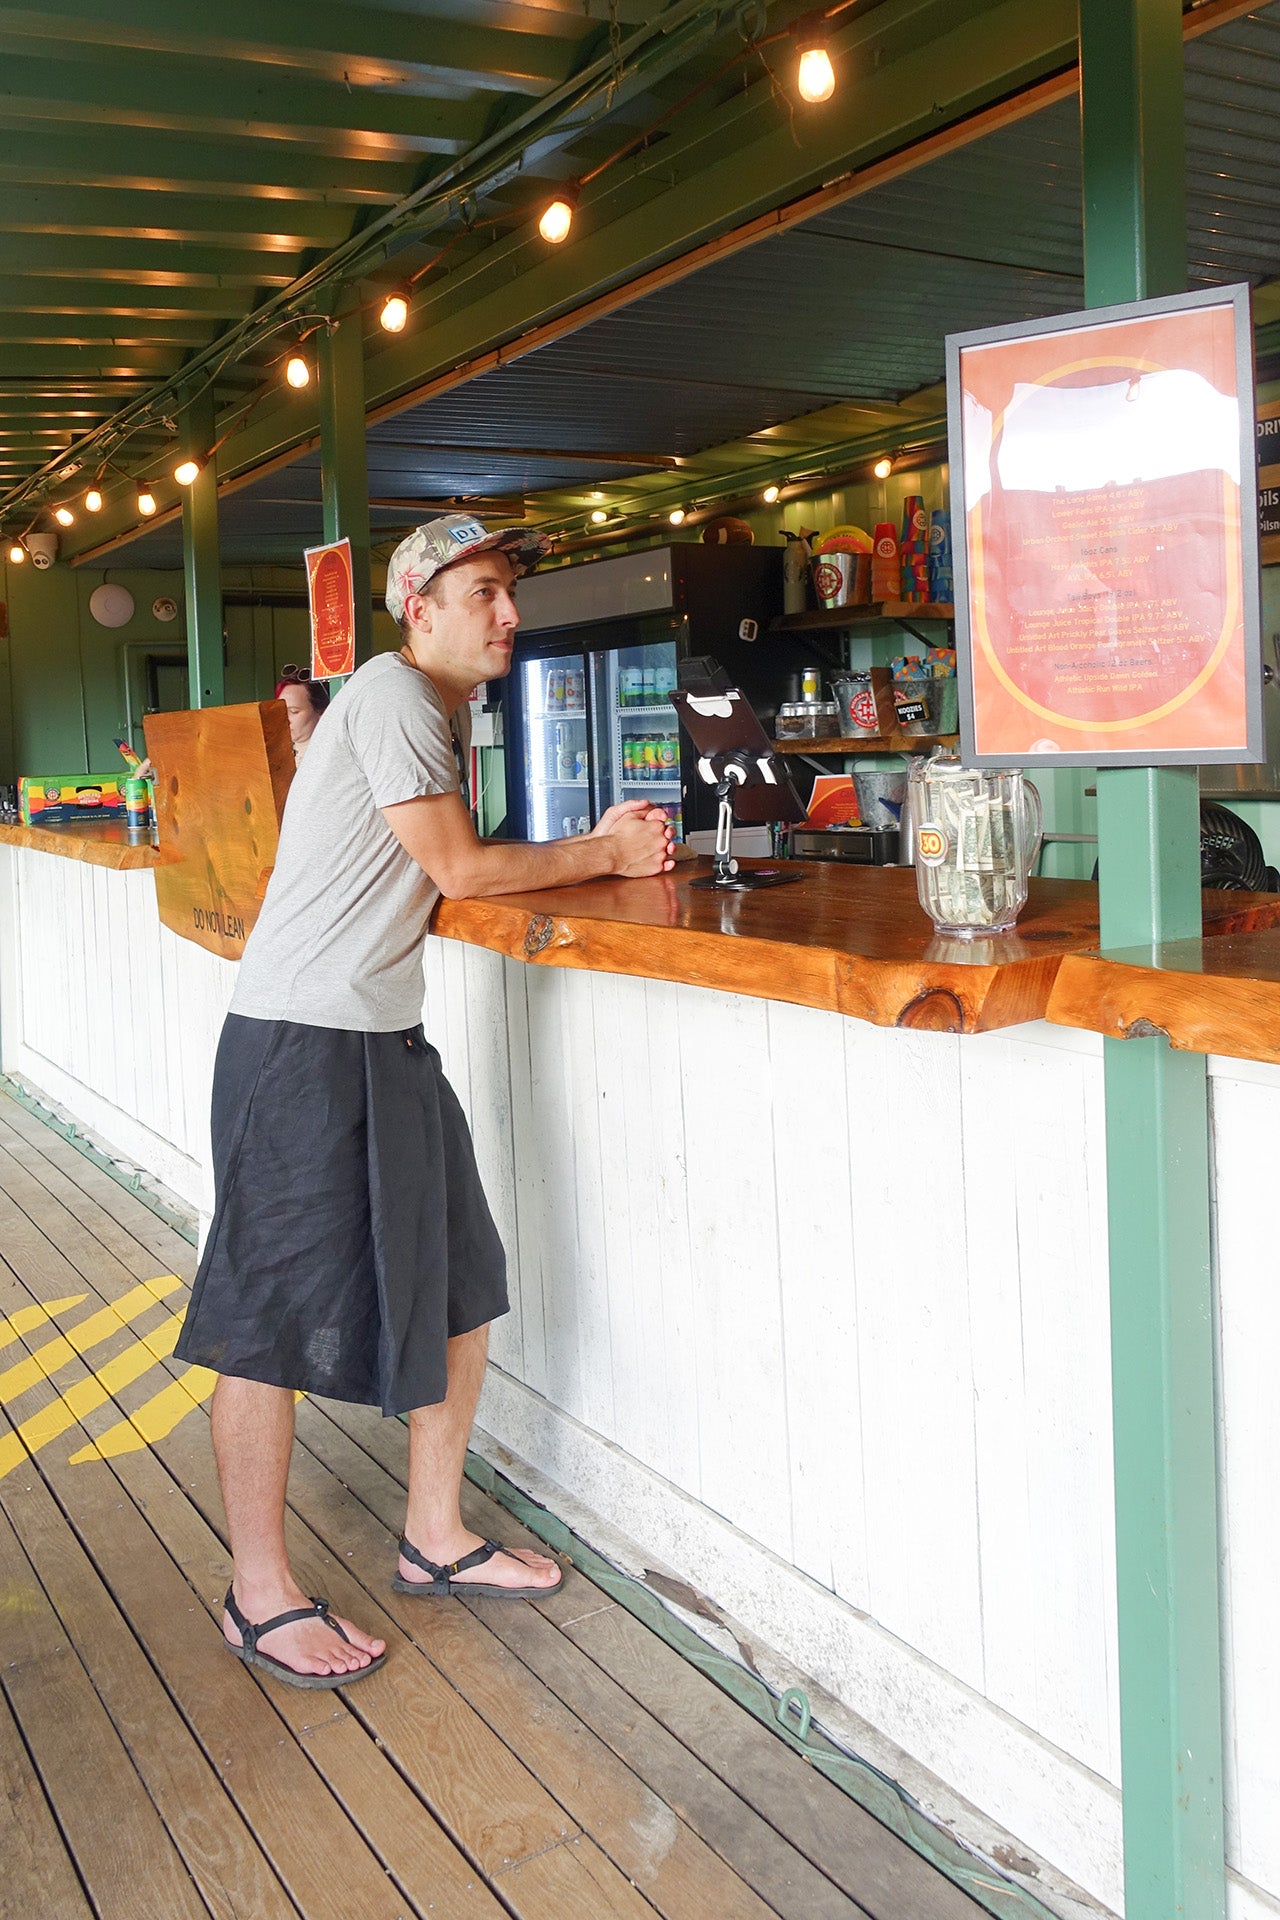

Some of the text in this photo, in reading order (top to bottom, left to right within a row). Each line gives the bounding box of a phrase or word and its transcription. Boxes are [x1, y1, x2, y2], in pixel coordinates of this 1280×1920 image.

[1128, 488, 1144, 498] ABV
[1129, 500, 1145, 510] ABV
[1118, 514, 1135, 524] ABV
[1162, 522, 1179, 533] ABV
[1099, 545, 1118, 555] Cans
[1099, 558, 1113, 568] IPA
[1133, 554, 1151, 564] ABV
[1117, 568, 1134, 578] ABV
[1126, 600, 1140, 609] IPA
[1162, 597, 1178, 607] ABV
[1024, 620, 1050, 630] Lounge
[1052, 618, 1072, 628] Juice
[1132, 613, 1145, 623] IPA
[1166, 610, 1183, 620] ABV
[1048, 631, 1060, 640] Art
[1132, 625, 1159, 635] Seltzer
[1173, 622, 1190, 632] ABV
[1006, 645, 1033, 656] Untitled
[1034, 644, 1047, 653] Art
[1047, 643, 1069, 653] Blood
[1069, 641, 1096, 652] Orange
[1188, 633, 1206, 643] ABV
[1129, 657, 1152, 667] Beers
[1083, 672, 1108, 683] Upside
[1096, 684, 1111, 693] Run
[1129, 682, 1143, 692] IPA
[193, 907, 246, 941] DO NOT LEAN
